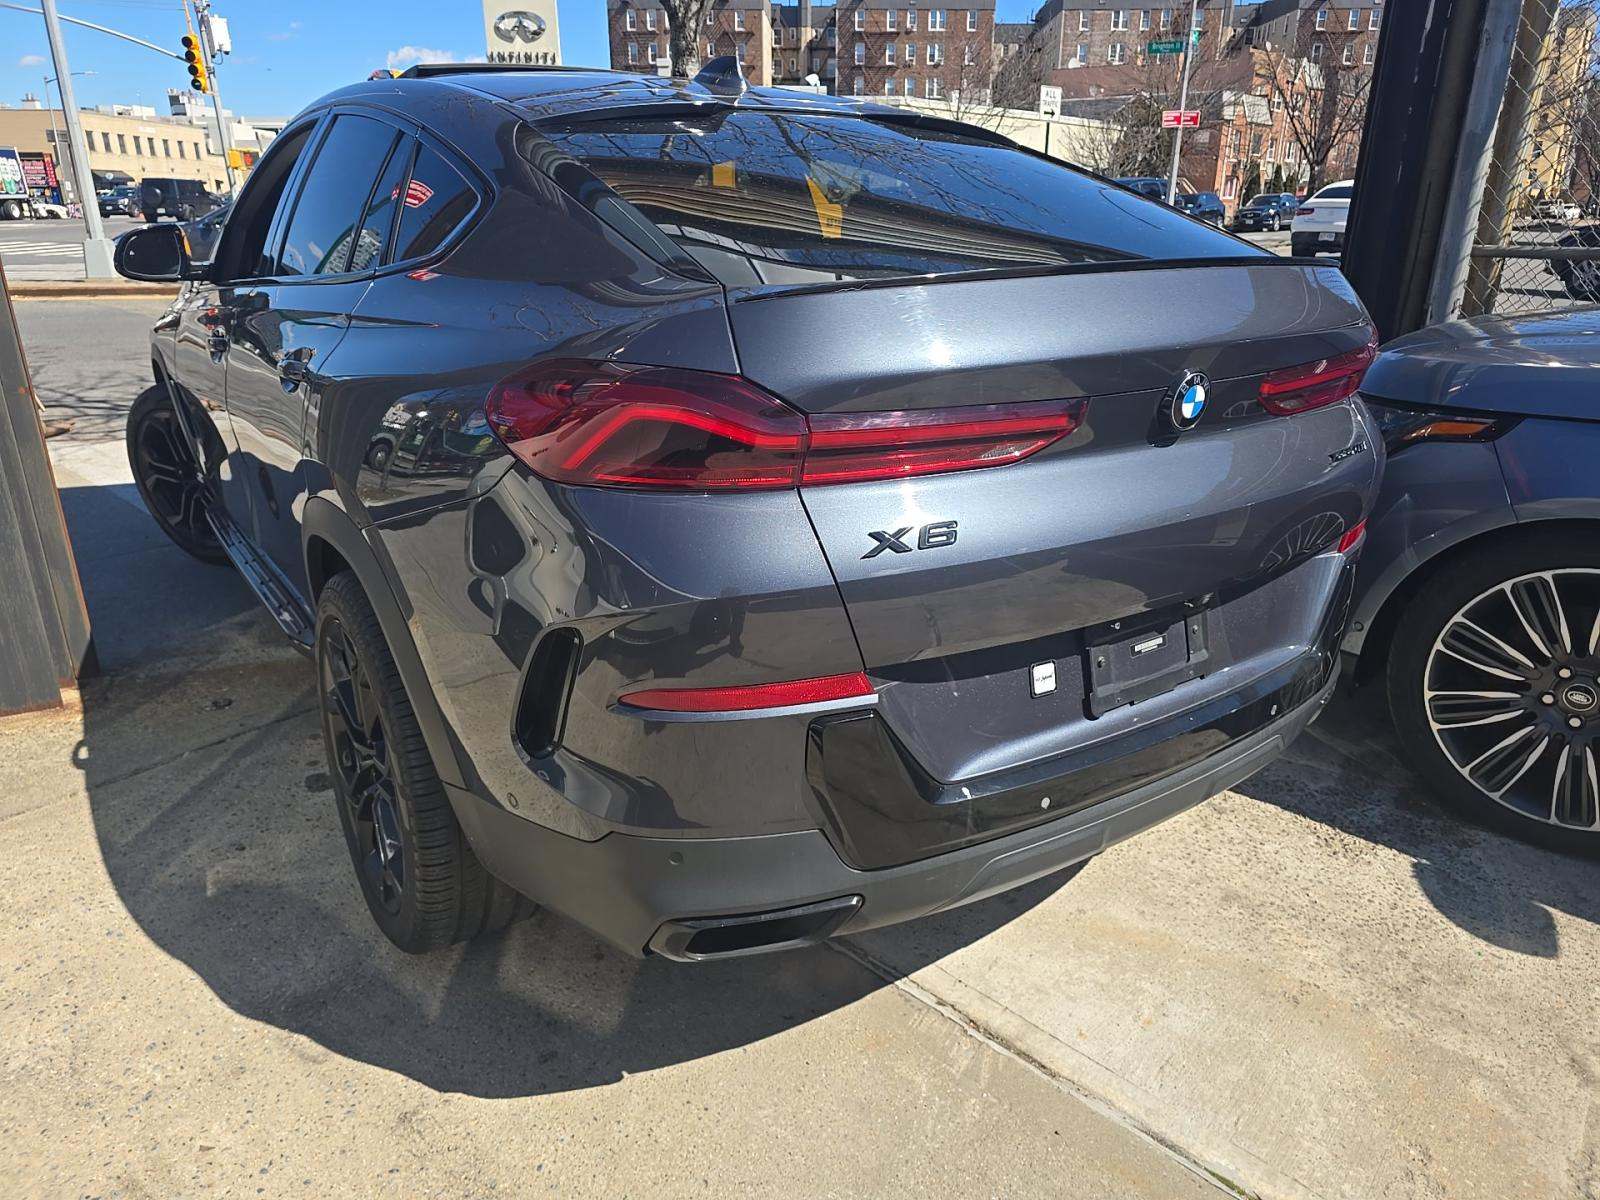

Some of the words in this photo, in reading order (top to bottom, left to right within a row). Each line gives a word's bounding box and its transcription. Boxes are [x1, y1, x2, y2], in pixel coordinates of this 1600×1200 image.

[1152, 42, 1175, 51] Brighton
[488, 51, 556, 64] INFINITI
[1045, 90, 1056, 98] ALL
[860, 520, 957, 560] X6
